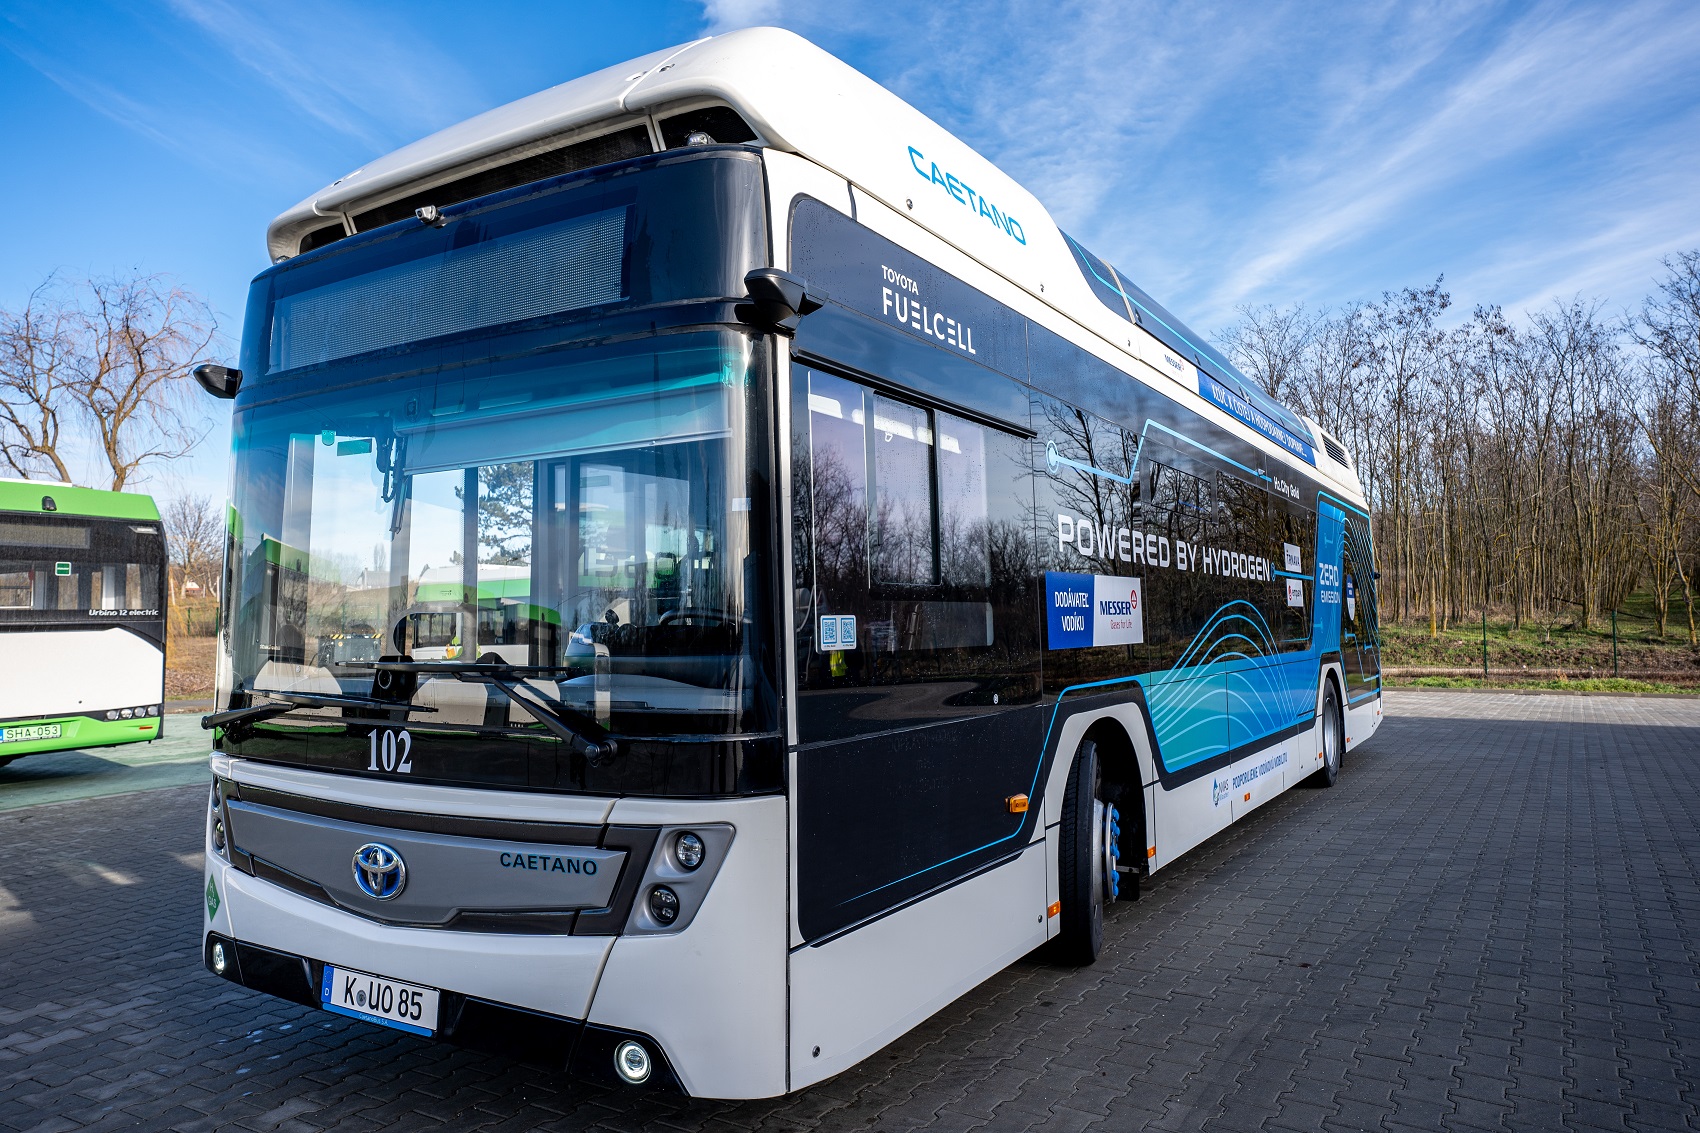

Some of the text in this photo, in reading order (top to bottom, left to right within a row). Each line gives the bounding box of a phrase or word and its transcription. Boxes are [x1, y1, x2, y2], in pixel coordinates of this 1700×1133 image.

[907, 145, 1027, 246] CAETANO
[882, 264, 919, 296] TOYOTA
[882, 286, 976, 355] FUELCELL
[1057, 513, 1271, 582] POWERED BY HYDROGEN
[1318, 562, 1340, 587] ZERO
[1099, 600, 1132, 615] MESSER
[1320, 590, 1341, 604] EMISSION
[88, 608, 118, 617] Urbino
[128, 608, 159, 617] electric
[1061, 612, 1085, 632] VODÍKU
[1110, 619, 1121, 630] Gases
[6, 725, 58, 739] SHA-053
[367, 728, 412, 774] 102
[500, 852, 598, 876] CAETANO
[324, 987, 330, 996] D
[344, 975, 358, 1005] K
[397, 988, 423, 1021] 85
